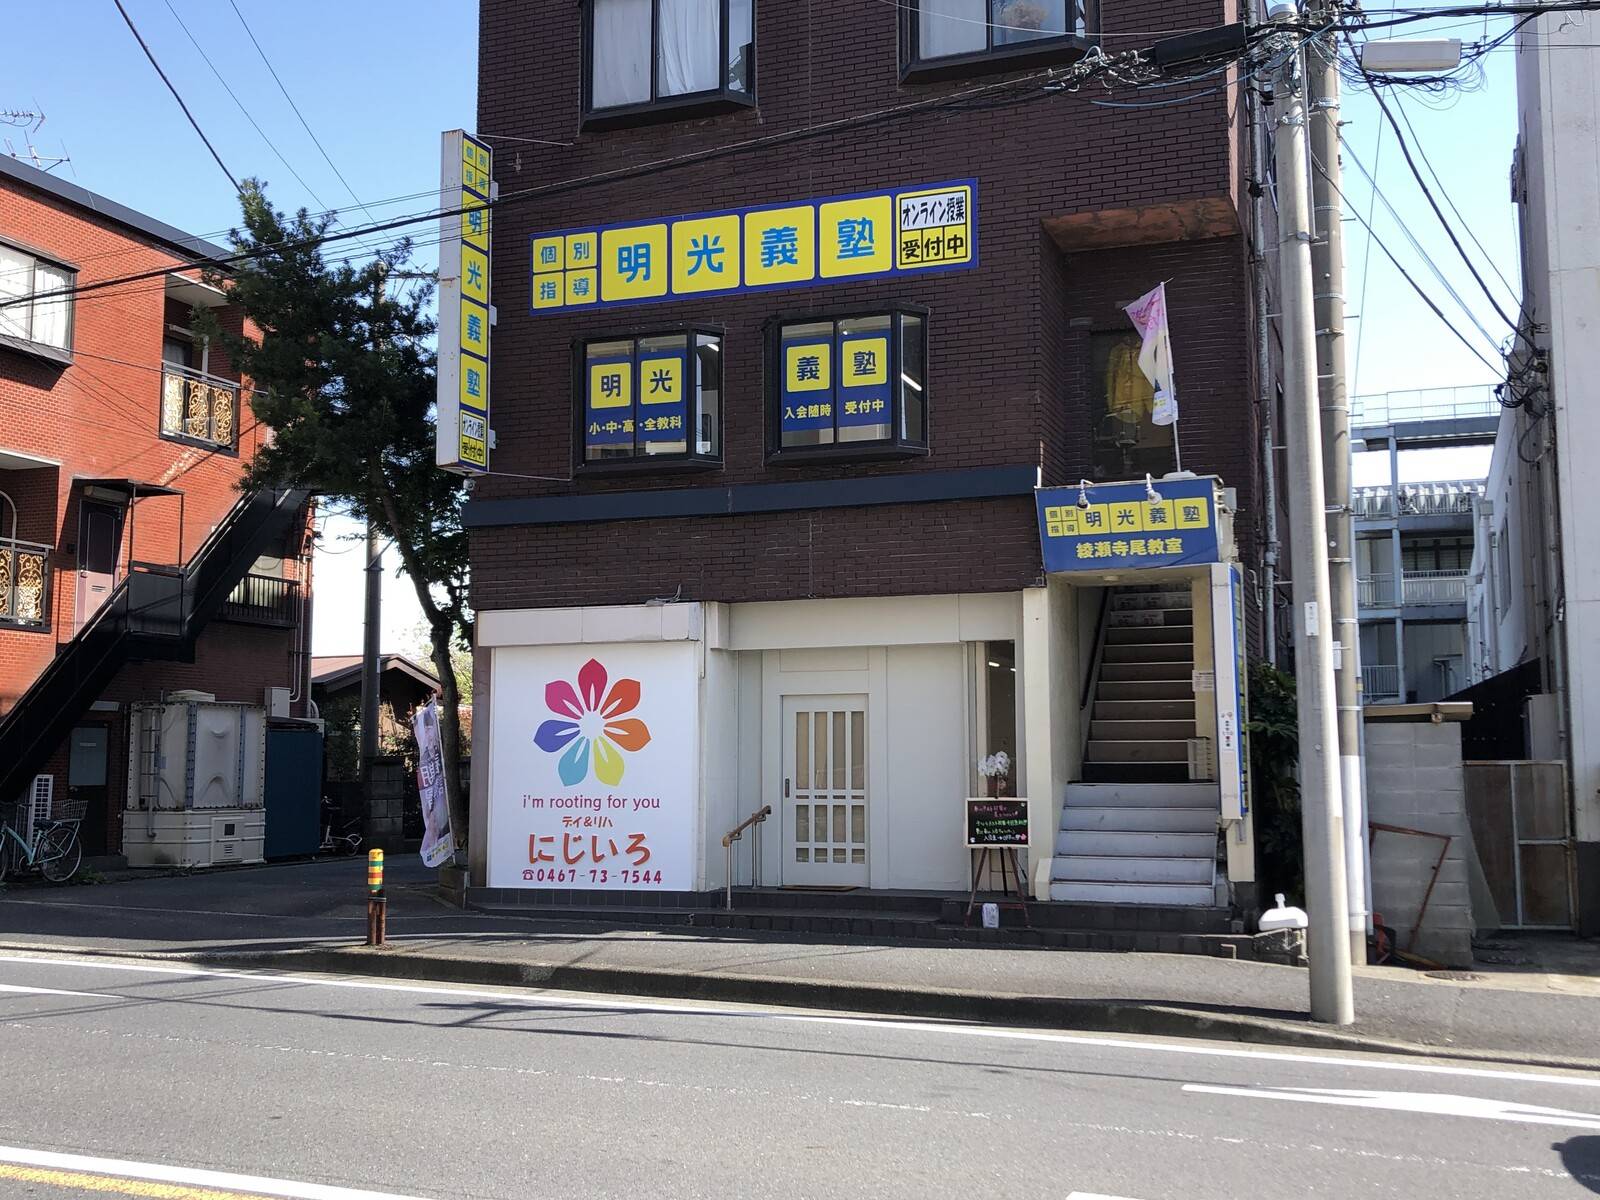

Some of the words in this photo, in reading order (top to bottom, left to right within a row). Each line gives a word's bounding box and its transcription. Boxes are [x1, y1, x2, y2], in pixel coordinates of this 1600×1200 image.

[902, 196, 965, 227] オンライン授業
[541, 241, 589, 264] 個別
[618, 217, 875, 283] 明光義塾
[903, 234, 964, 259] 受付中
[540, 278, 589, 300] 指導
[797, 350, 877, 382] 義塾
[600, 369, 673, 398] 明光
[784, 403, 831, 419] 入会随時
[845, 399, 884, 415] 受付中
[1086, 507, 1200, 527] 明光義塾
[1076, 538, 1183, 558] 綾瀬寺尾教室
[523, 795, 543, 808] i'm
[550, 795, 602, 811] rooting
[607, 795, 628, 808] for
[633, 798, 660, 811] you
[529, 832, 650, 866] にじいろ
